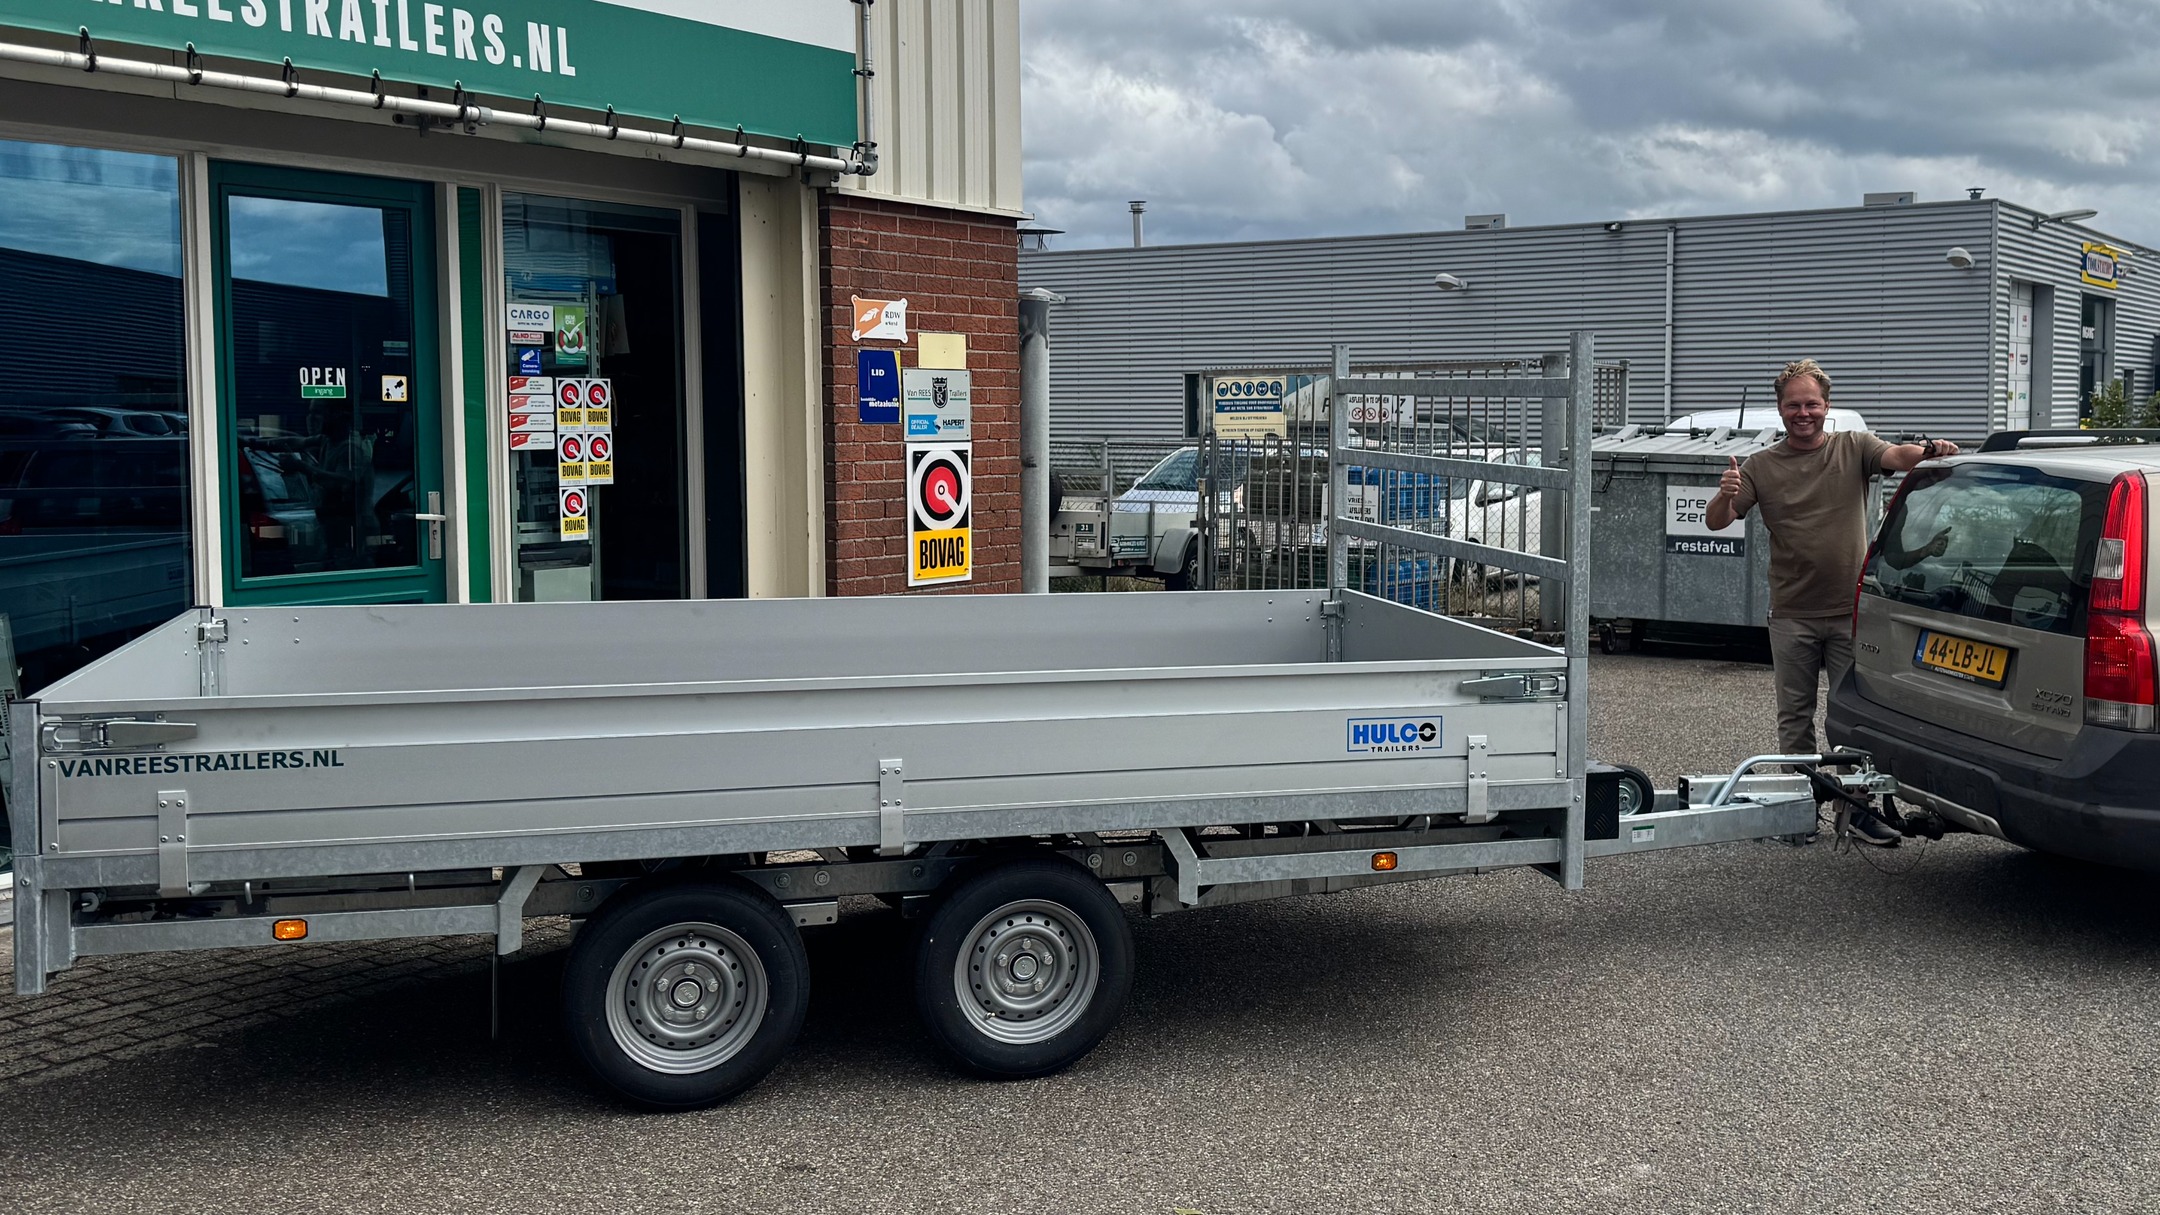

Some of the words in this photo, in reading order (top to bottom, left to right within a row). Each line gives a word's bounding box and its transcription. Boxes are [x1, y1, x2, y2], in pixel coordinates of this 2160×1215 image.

[510, 309, 550, 320] CARGO
[885, 311, 901, 319] RDW
[299, 366, 346, 386] OPEN
[871, 368, 885, 377] LID
[907, 389, 918, 397] Van
[918, 389, 931, 397] REES
[949, 389, 967, 397] Trailers
[560, 410, 581, 423] BOVAG
[587, 410, 608, 423] BOVAG
[562, 464, 583, 477] BOVAG
[590, 463, 610, 476] BOVAG
[1676, 498, 1707, 511] pre
[1676, 512, 1705, 523] zer
[564, 518, 585, 531] BOVAG
[919, 536, 964, 570] BOVAG
[1675, 539, 1735, 554] restafval
[1929, 637, 1996, 676] 44-LB-JL
[1353, 722, 1437, 744] HULCO
[1371, 744, 1420, 753] TRAILERS
[58, 749, 345, 778] VANREESTRAILERS.NL
